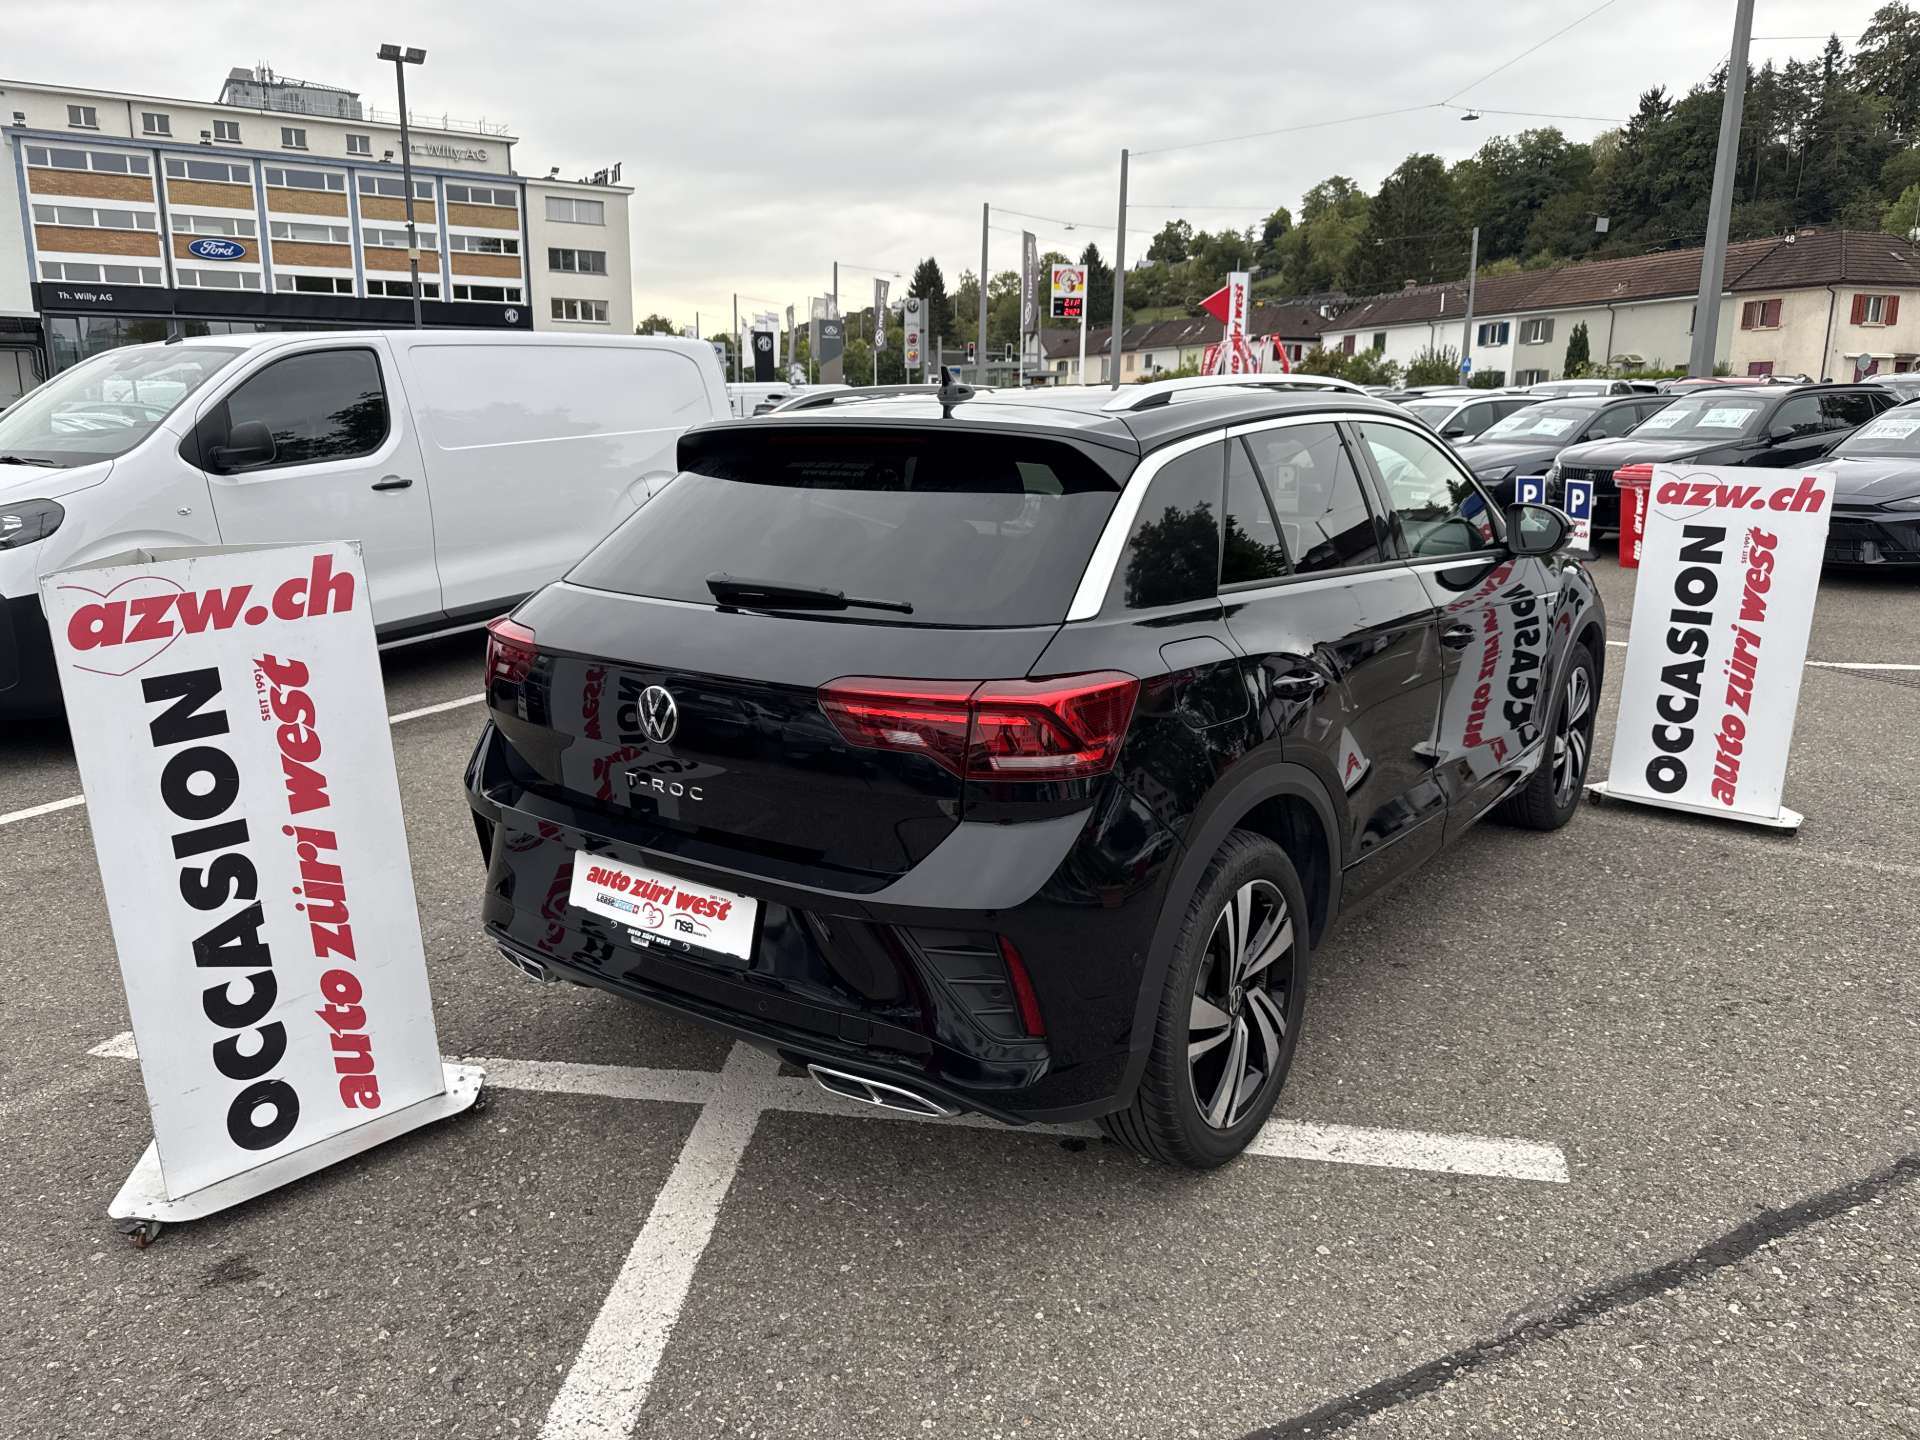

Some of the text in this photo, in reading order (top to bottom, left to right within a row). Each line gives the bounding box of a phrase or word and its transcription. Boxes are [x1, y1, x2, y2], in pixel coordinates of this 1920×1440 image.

[426, 143, 463, 161] Willy
[465, 149, 489, 161] AG
[200, 240, 234, 256] Ford
[1784, 235, 1795, 243] 48
[57, 291, 113, 302] Th. Willy AG
[1234, 283, 1244, 319] west
[757, 336, 772, 352] MG
[1523, 484, 1538, 503] P
[1571, 488, 1585, 514] P
[1657, 477, 1826, 513] azw.ch
[1744, 531, 1752, 548] 1991
[67, 554, 355, 652] azw.ch
[1646, 525, 1727, 794] OCCASION
[1711, 526, 1778, 806] auto züri west
[254, 668, 271, 722] SEIT 1991
[624, 771, 704, 801] T-ROC
[253, 653, 382, 1111] auto züri west
[586, 865, 732, 921] auto züri west
[141, 666, 302, 1151] OCCASION
[627, 928, 642, 937] auto
[656, 937, 672, 947] west
[674, 918, 694, 934] nsa
